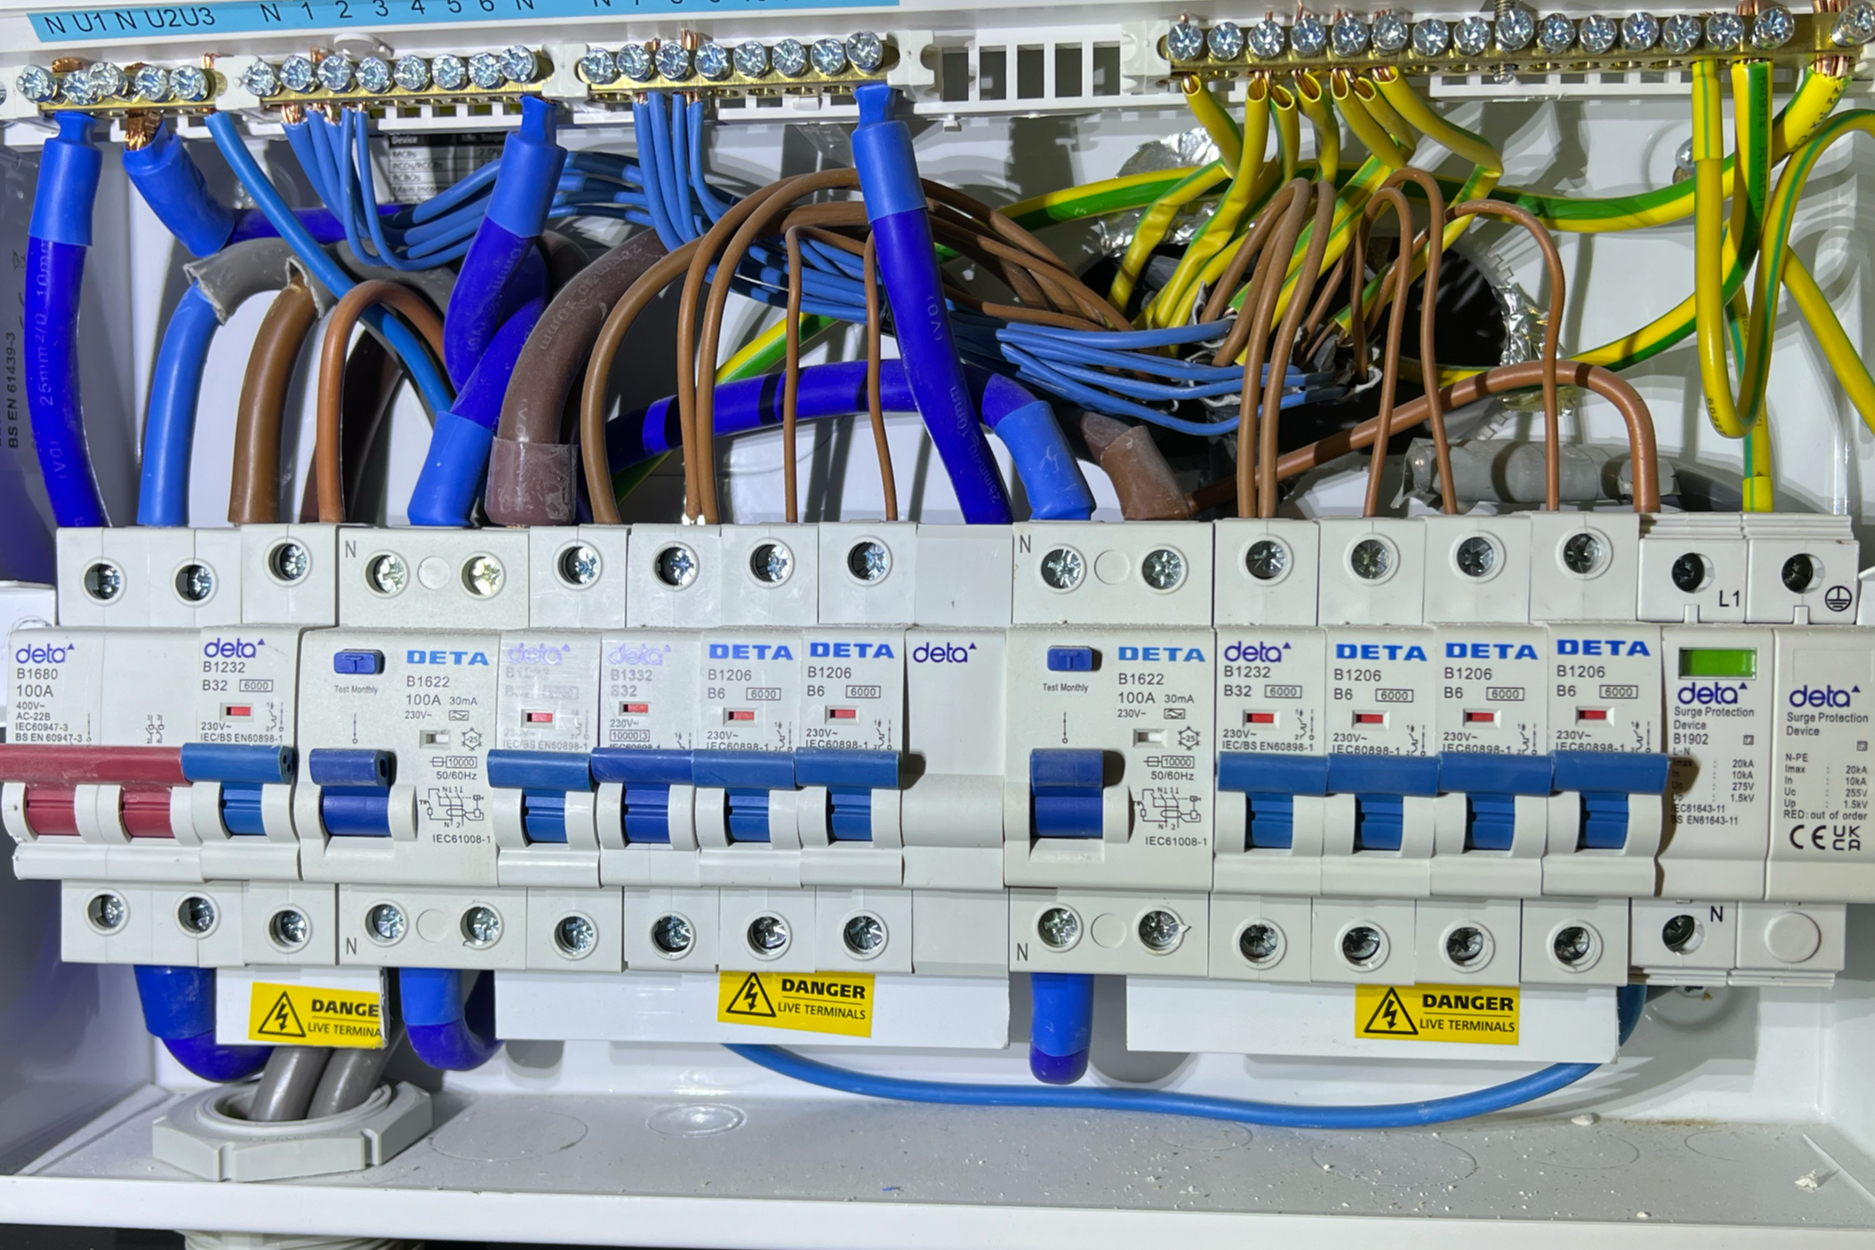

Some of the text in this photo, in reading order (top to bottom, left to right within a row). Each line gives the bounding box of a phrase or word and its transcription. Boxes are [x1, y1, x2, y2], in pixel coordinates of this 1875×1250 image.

[259, 4, 282, 22] N
[301, 2, 313, 20] 1
[339, 0, 353, 18] 2
[375, 0, 389, 17] 3
[411, 0, 425, 15] 4
[449, 0, 462, 13] 5
[480, 0, 494, 11] 6
[44, 16, 66, 34] N
[72, 14, 107, 32] U1
[115, 11, 137, 29] N
[391, 135, 418, 144] Device
[6, 332, 18, 449] BS EN 61439-3
[345, 539, 357, 558] N
[1019, 535, 1032, 553] N
[1719, 590, 1740, 607] L1
[16, 643, 66, 664] deta
[204, 638, 257, 658] deta
[709, 644, 793, 660] DETA
[810, 643, 894, 659] DETA
[913, 642, 968, 663] deta
[1224, 641, 1282, 663] deta
[1336, 643, 1427, 661] DETA
[1445, 642, 1539, 660] DETA
[1556, 639, 1651, 656] DETA
[406, 650, 489, 666] DETA
[507, 643, 562, 665] deta
[608, 643, 663, 666] deta
[1118, 647, 1206, 662] DETA
[203, 661, 245, 673] B1232
[808, 667, 852, 679] B1206
[1224, 665, 1271, 678] B1232
[1556, 665, 1605, 678] B1206
[17, 668, 58, 680] B1680
[611, 669, 653, 681] B1332
[708, 669, 752, 681] B1206
[1118, 673, 1164, 685] B1622
[1334, 668, 1381, 681] B1206
[1444, 667, 1492, 680] B1206
[202, 680, 269, 691] B32 6000
[407, 675, 450, 687] B1622
[17, 684, 54, 698] 100A
[335, 685, 378, 695] Test Monthly
[708, 687, 777, 699] B6 6000
[807, 685, 876, 697] B6 6000
[1043, 684, 1088, 694] Test Monthly
[1224, 684, 1297, 697] B32 6000
[1334, 688, 1409, 701] B6 6000
[1444, 686, 1520, 699] B6 6000
[1556, 684, 1633, 697] B6 6000
[1677, 681, 1739, 704] deta
[406, 694, 478, 706] 100A 30mA
[1118, 692, 1195, 704] 100A 30mA
[1789, 684, 1850, 708] deta
[16, 712, 51, 721] AC-22B
[1674, 706, 1755, 718] Surge Protection
[1786, 711, 1869, 725] Surge Protection
[16, 722, 69, 732] IEC60947-3
[1674, 720, 1707, 730] Device
[1786, 725, 1820, 736] Device
[15, 733, 82, 743] BS EN 60947-3
[200, 733, 283, 743] IEC/BS EN60898-1
[612, 731, 648, 739] 10000 3
[1673, 733, 1709, 745] B1902
[503, 740, 588, 751] IEC/BS EN60898-1
[706, 742, 769, 751] IEC60898-1
[805, 740, 869, 750] IEC60898-1
[1222, 740, 1313, 752] IEC/BS EN60898-1
[1332, 744, 1401, 755] IEC60898-1
[1442, 743, 1511, 754] IEC60898-1
[1555, 742, 1625, 752] IEC60898-1
[448, 758, 475, 767] 10000
[1164, 758, 1192, 767] 10000
[1732, 759, 1755, 768] 20kA
[1785, 753, 1808, 762] N-PE
[436, 771, 477, 780] 50/60Hz
[1151, 771, 1194, 780] 50/60Hz
[1732, 771, 1754, 780] 10kA
[1785, 764, 1868, 775] Imax 20kA
[1732, 782, 1755, 791] 275V
[1845, 777, 1867, 786] 10kA
[1730, 794, 1755, 803] 1.5kV
[1784, 787, 1868, 798] Uc 255V
[1784, 799, 1868, 809] Up 1.5kV
[1671, 815, 1738, 826] BS EN61643-11
[1810, 811, 1825, 820] out
[1829, 811, 1839, 819] of
[1842, 812, 1867, 821] order
[432, 834, 491, 844] IEC61008-1
[1145, 836, 1207, 846] IEC61008-1
[1710, 905, 1724, 922] N
[346, 937, 357, 955] N
[1016, 943, 1029, 962] N
[781, 978, 866, 999] DANGER
[1422, 994, 1514, 1011] DANGER
[778, 1002, 866, 1020] LIVE TERMINALS
[307, 1022, 330, 1034] LIVE
[1420, 1018, 1515, 1033] LIVE TERMINALS
